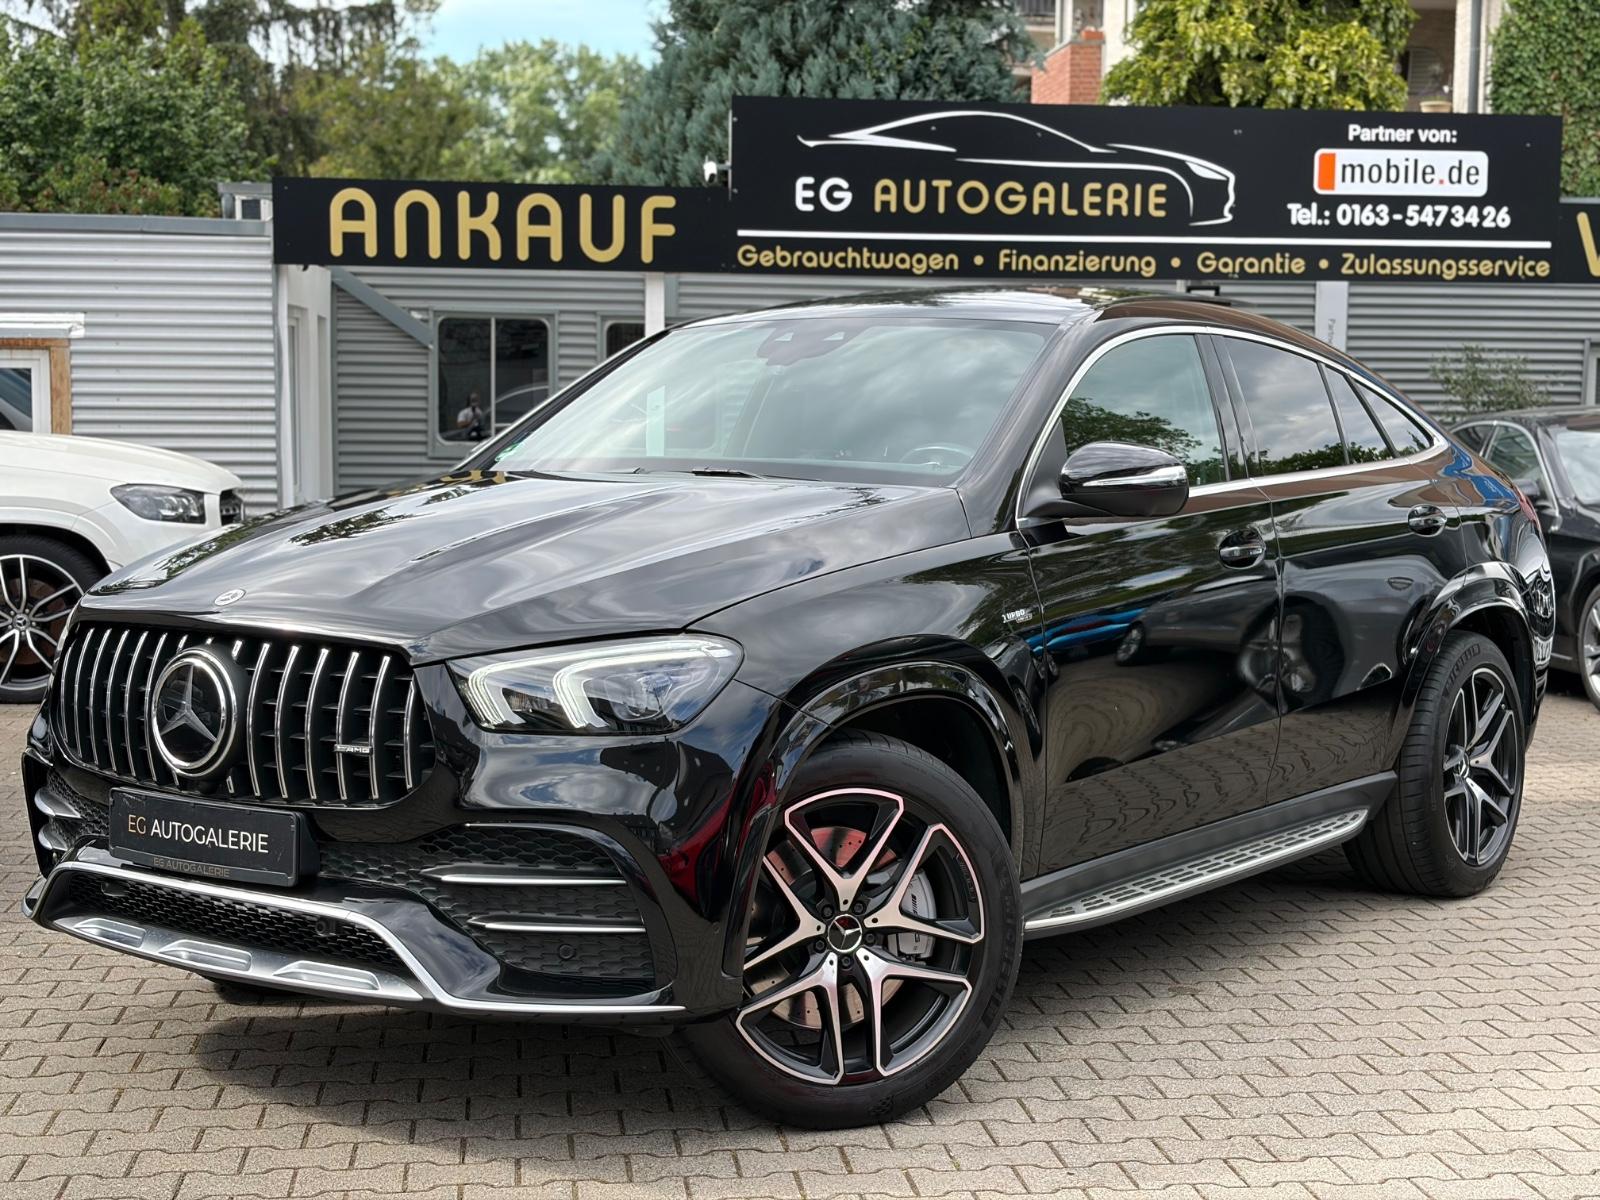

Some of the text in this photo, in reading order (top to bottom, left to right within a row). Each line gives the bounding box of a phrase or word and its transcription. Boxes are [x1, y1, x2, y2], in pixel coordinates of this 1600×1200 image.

[1347, 124, 1458, 143] Partner von:
[1341, 158, 1480, 186] mobile.de
[795, 176, 1168, 218] EG AUTOGALERIE
[329, 186, 677, 265] ANKAUF
[1287, 202, 1331, 226] Tel.:
[736, 243, 960, 275] Gebrauchtwagen
[998, 248, 1157, 278] Finanzierung
[1197, 251, 1306, 275] Garantie
[1340, 253, 1551, 281] Zulassungsservice
[1441, 643, 1481, 698] MICHELIN
[127, 814, 270, 854] EG AUTOGALERIE
[153, 857, 231, 878] EG AUTOGALERIE
